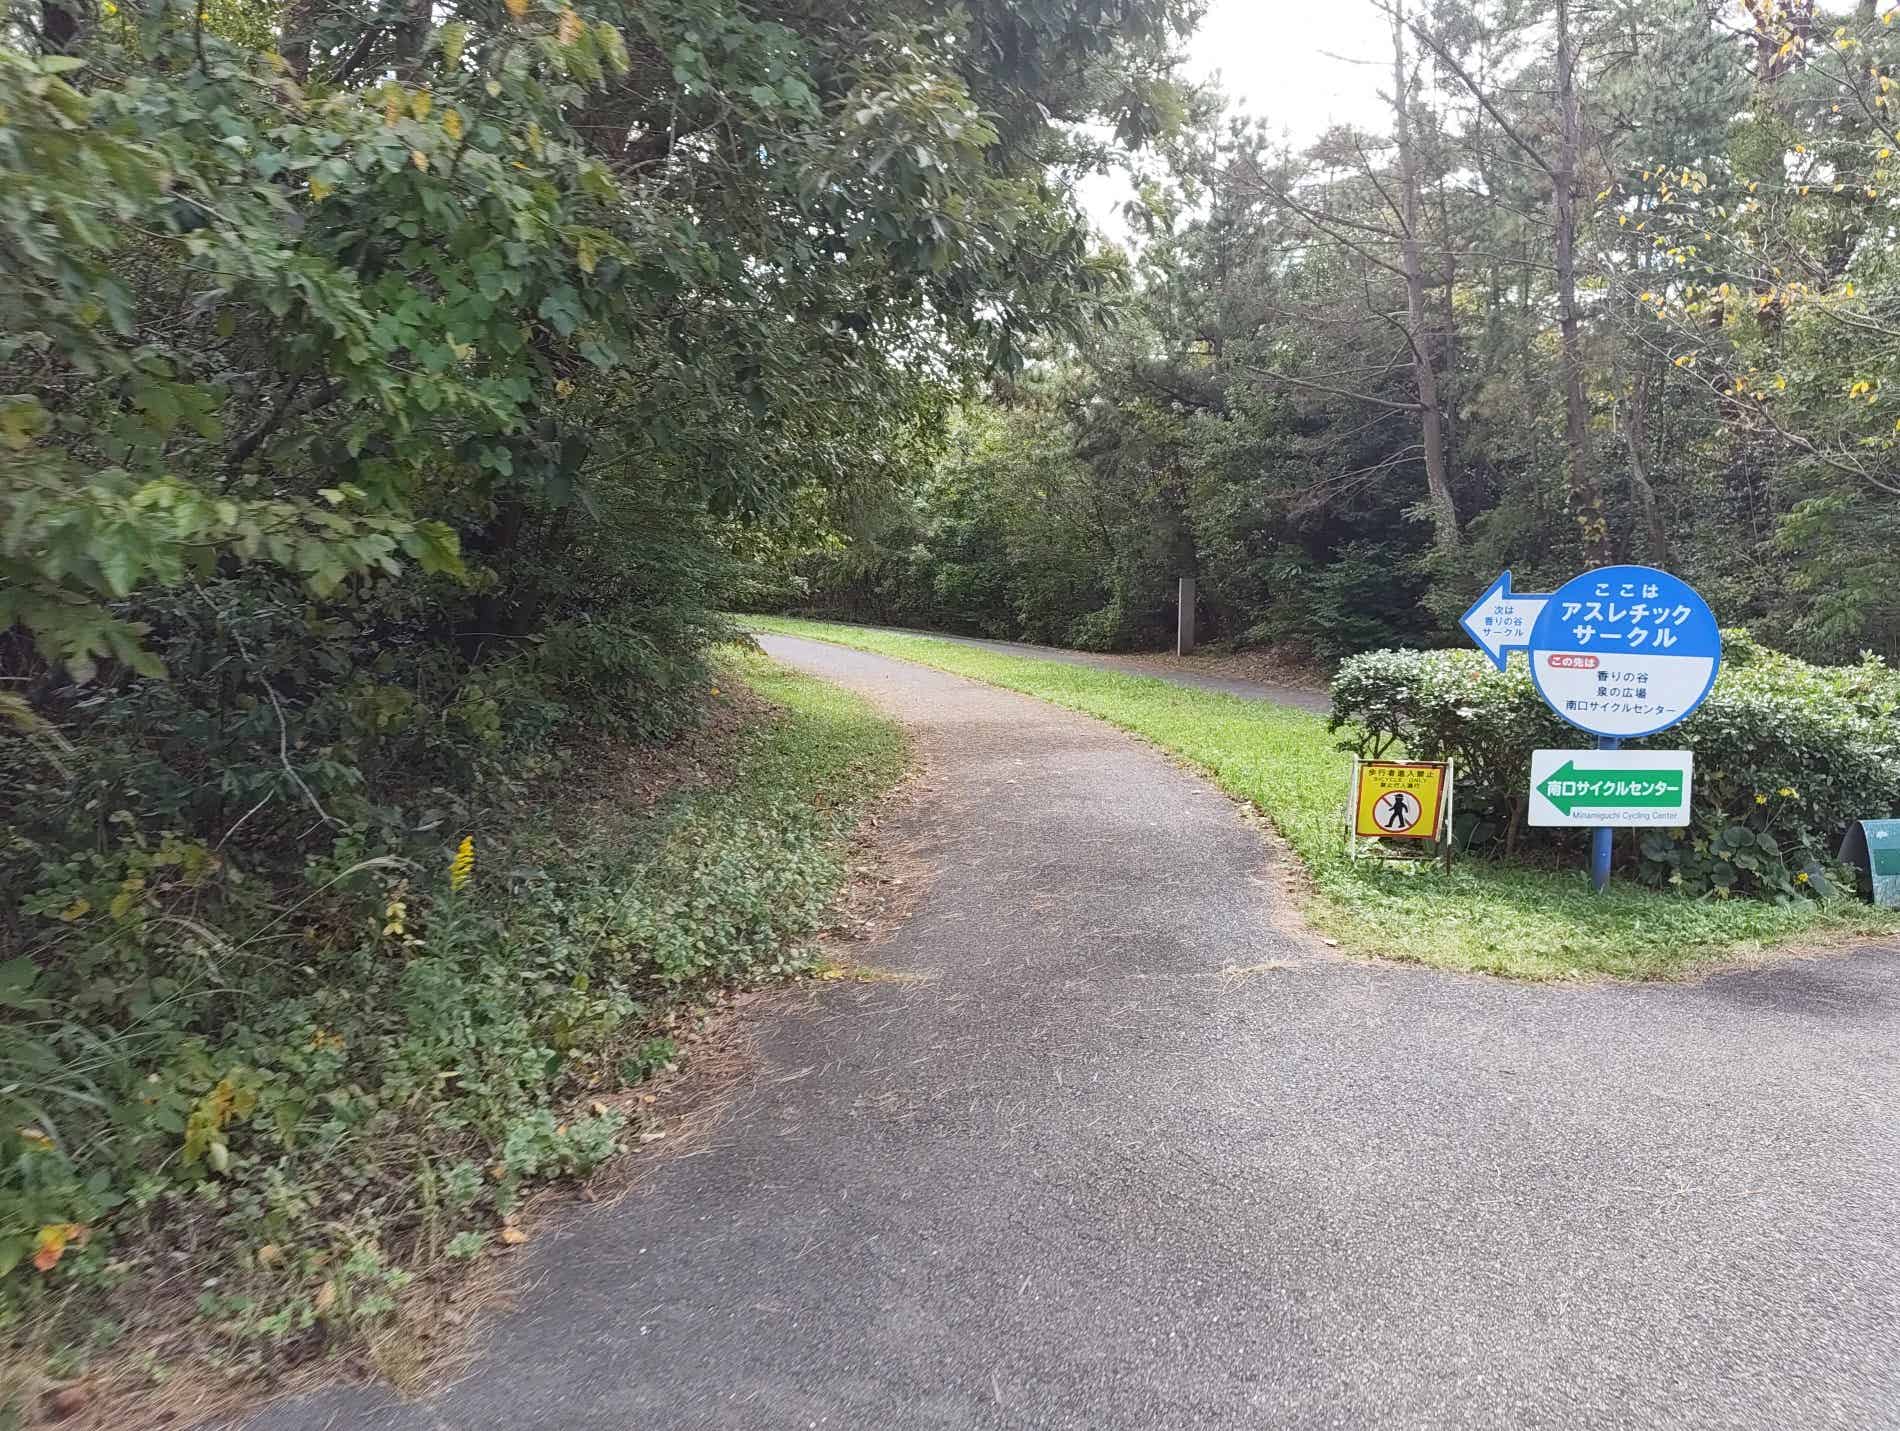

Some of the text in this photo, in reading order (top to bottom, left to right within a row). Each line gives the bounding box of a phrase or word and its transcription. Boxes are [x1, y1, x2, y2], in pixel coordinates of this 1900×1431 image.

[1594, 583, 1659, 599] ここは
[1494, 605, 1514, 615] 次は
[1561, 602, 1692, 626] アスレチック
[1484, 616, 1523, 626] 香りの谷
[1482, 628, 1524, 637] サークル
[1573, 624, 1678, 648] サークル
[1551, 656, 1596, 668] この先は
[1597, 671, 1649, 684] 香りの谷
[1596, 686, 1647, 699] 泉の広場
[1565, 700, 1676, 715] 南口サイクルセンター
[1547, 780, 1680, 797] 南口サイクルセンター
[1572, 811, 1678, 821] Minamiguchi Cycling Center
